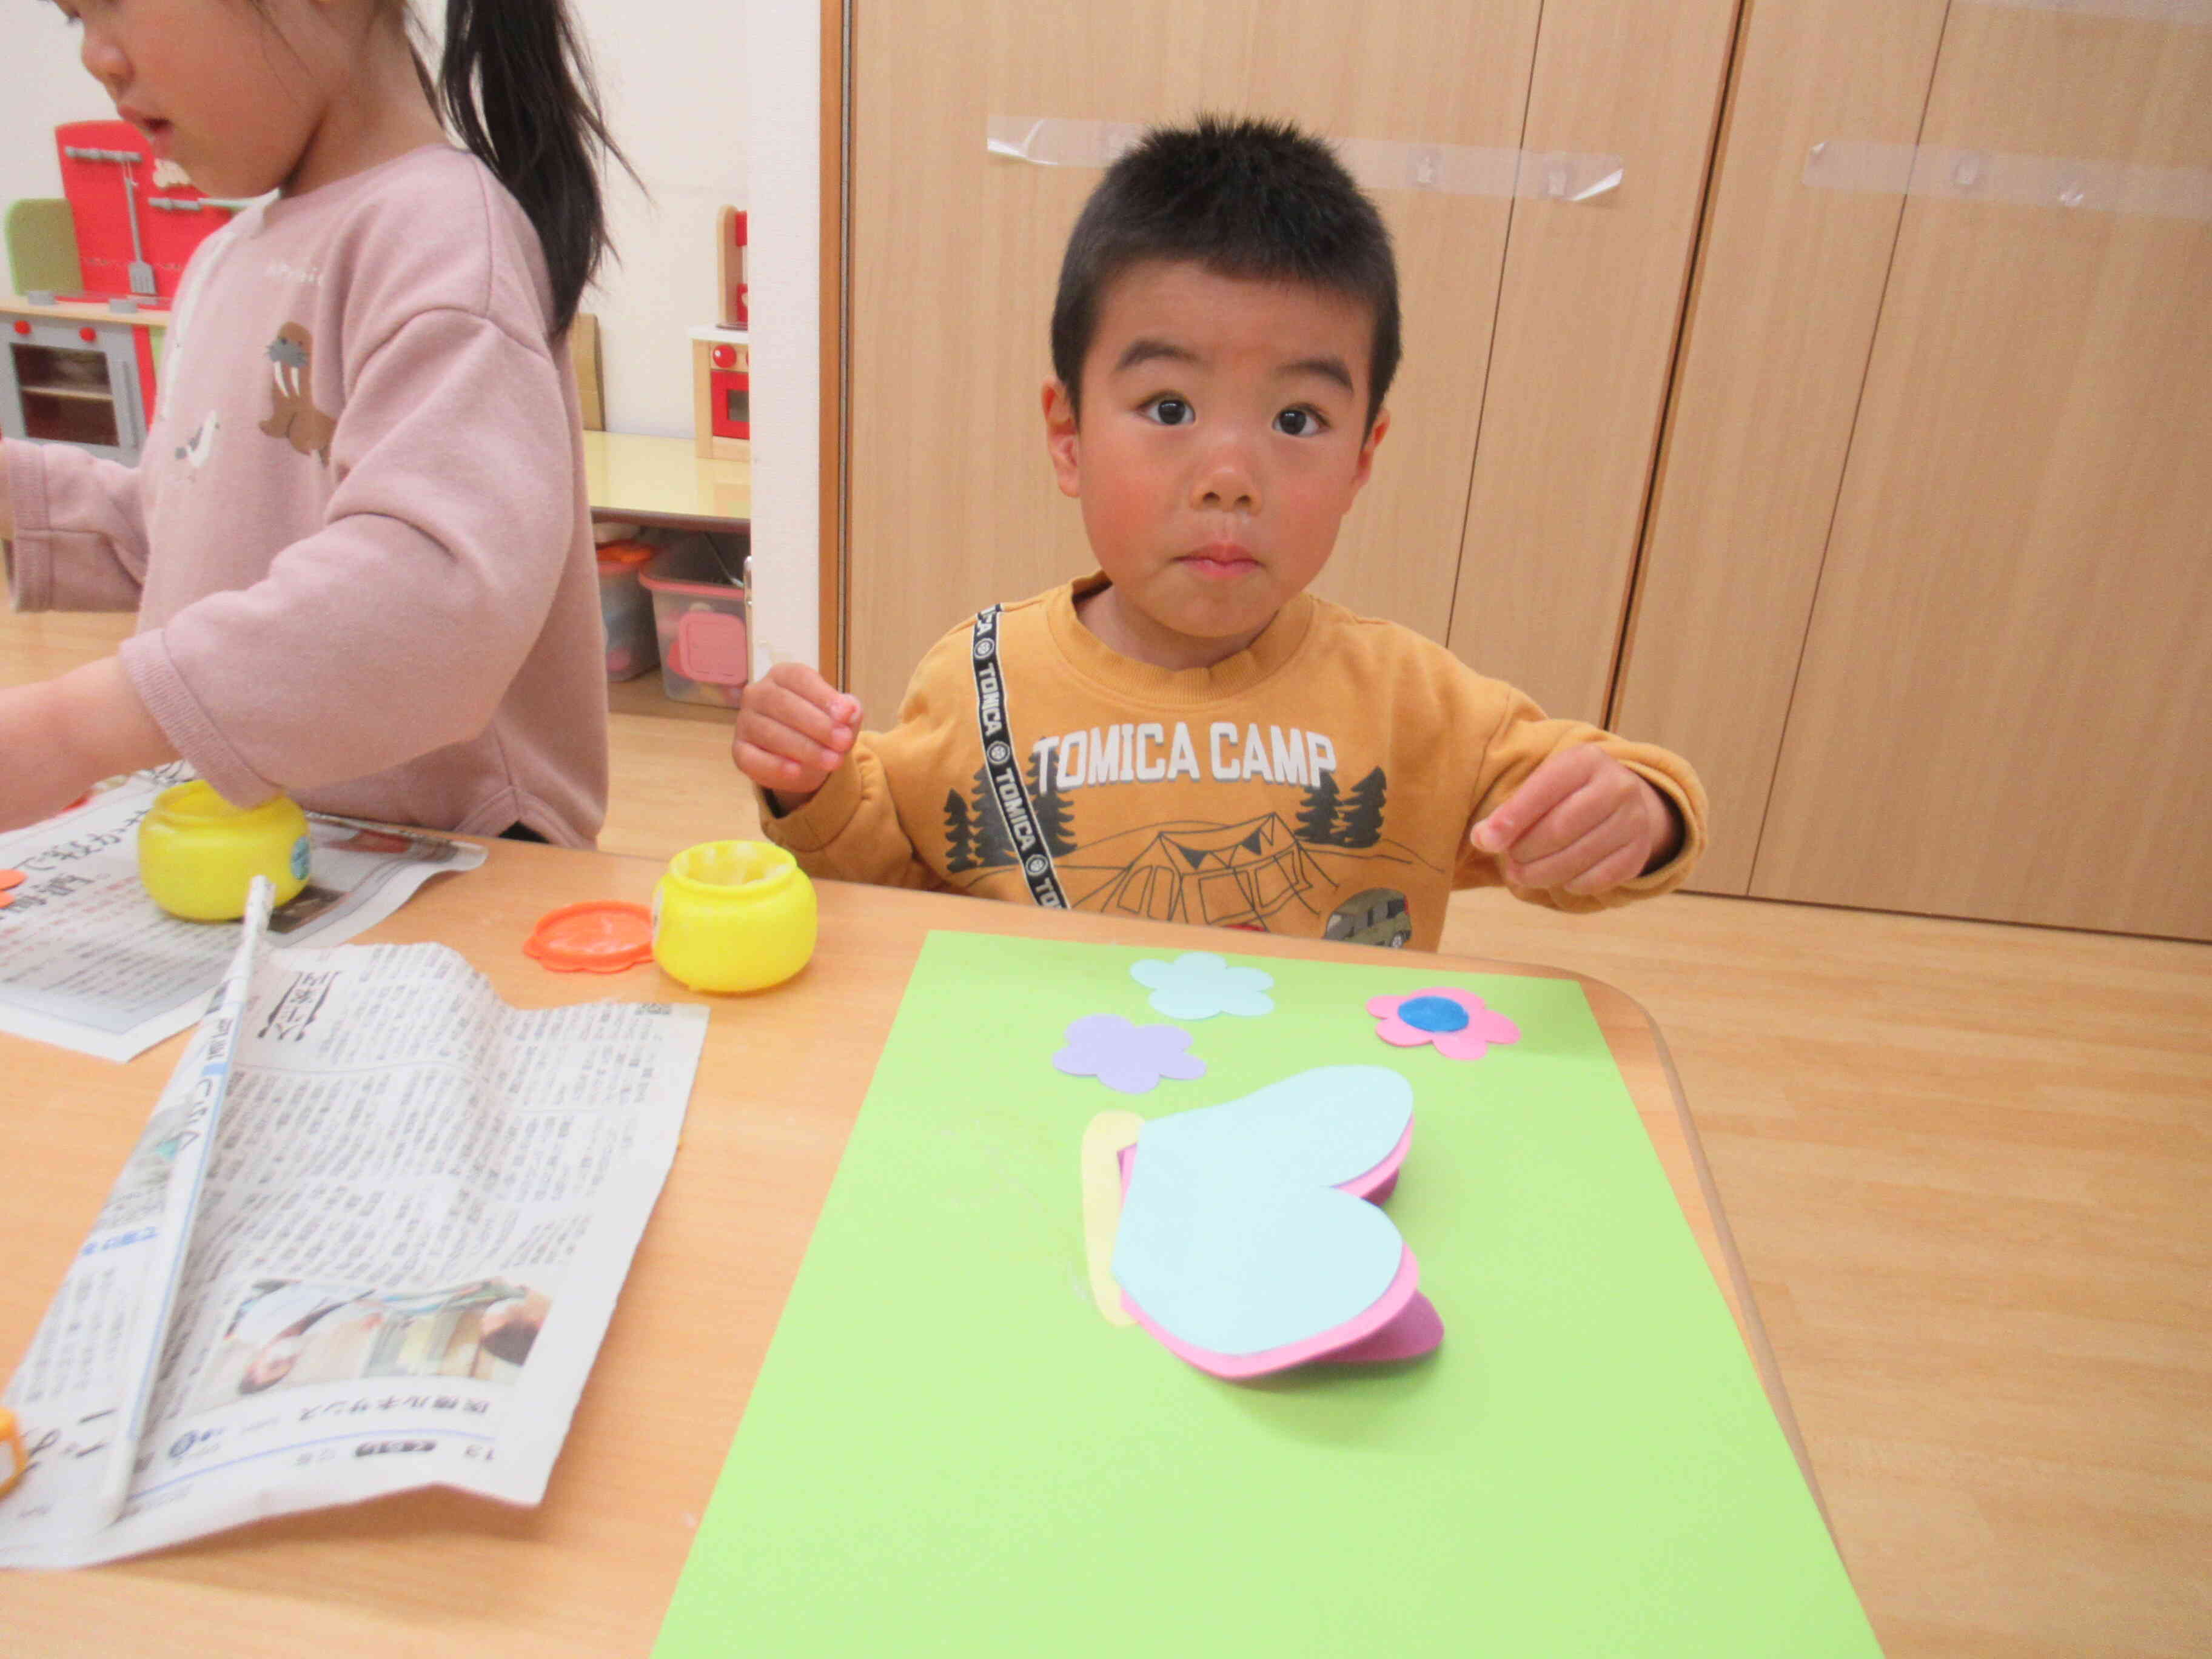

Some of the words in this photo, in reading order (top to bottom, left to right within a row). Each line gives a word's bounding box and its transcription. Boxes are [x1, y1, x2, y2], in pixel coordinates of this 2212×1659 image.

[979, 662, 1002, 737] TOMICA
[1033, 722, 1201, 796] TOMICA
[1210, 721, 1336, 789] CAMP
[996, 767, 1036, 851] TOMICA
